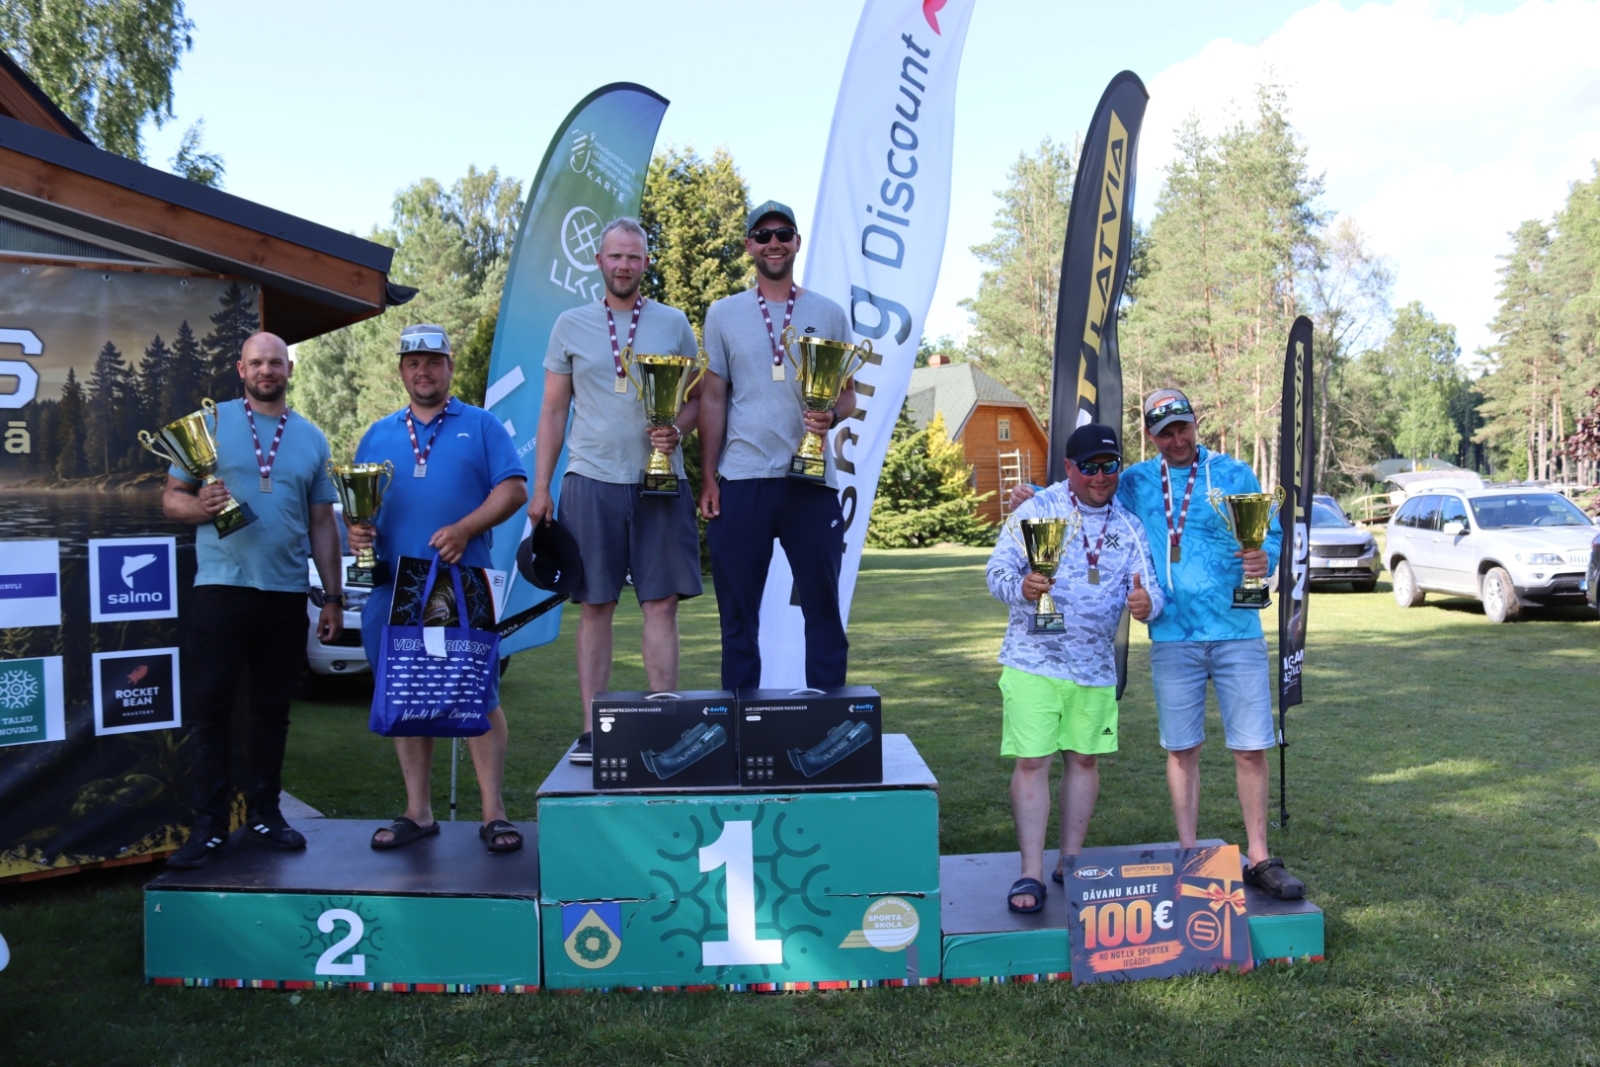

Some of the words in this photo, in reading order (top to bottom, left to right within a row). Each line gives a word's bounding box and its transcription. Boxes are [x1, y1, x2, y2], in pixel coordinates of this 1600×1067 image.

[861, 32, 931, 270] Discount
[586, 168, 625, 203] KARTE
[1089, 138, 1125, 338] LATVIA
[107, 590, 163, 605] salmo
[115, 686, 159, 699] ROCKET
[122, 696, 153, 708] BEAN
[2, 715, 34, 725] TALSU
[0, 725, 39, 736] NOVADS
[1123, 864, 1161, 873] SPORTEX
[699, 820, 783, 966] 1
[1083, 886, 1122, 901] DĀVANU
[1126, 883, 1158, 897] KARTE
[870, 900, 886, 913] TALSU
[887, 899, 911, 912] NOVADA
[867, 914, 902, 922] SPORTA
[874, 921, 903, 929] SKOLA
[1079, 899, 1174, 950] 100€
[315, 908, 366, 976] 2
[1098, 952, 1109, 961] NO
[1110, 949, 1135, 959] NGT.LV
[1137, 945, 1170, 956] SPORTEX
